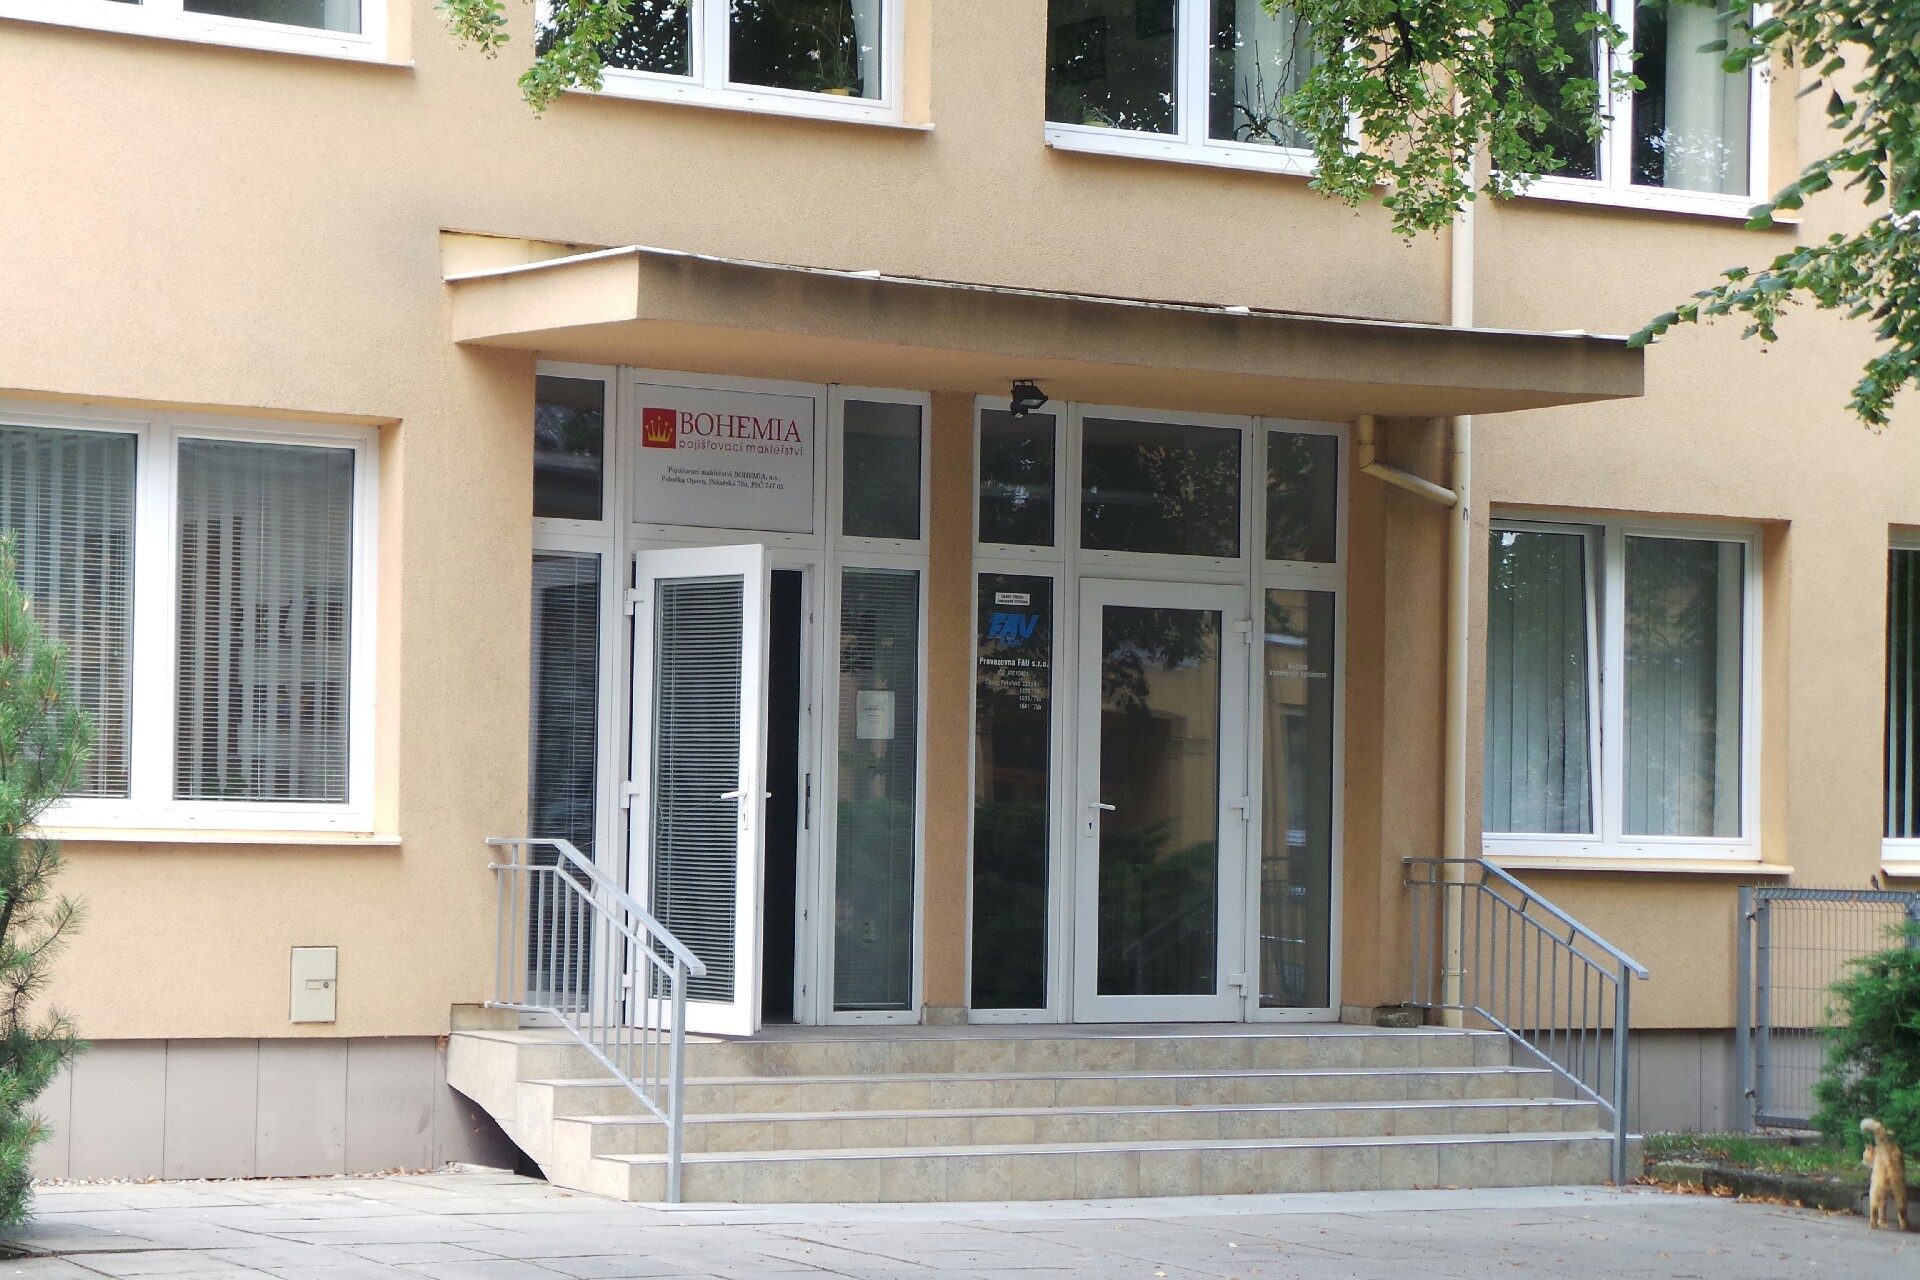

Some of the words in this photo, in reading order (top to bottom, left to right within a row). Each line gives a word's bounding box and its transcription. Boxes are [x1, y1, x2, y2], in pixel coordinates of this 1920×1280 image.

[679, 411, 802, 443] BOHEMIA
[679, 438, 743, 452] pojišťovací
[734, 471, 768, 480] BOHEMIA,
[979, 657, 1016, 666] Provozovna
[1017, 659, 1030, 667] FAU
[1031, 660, 1049, 668] s.r.o.
